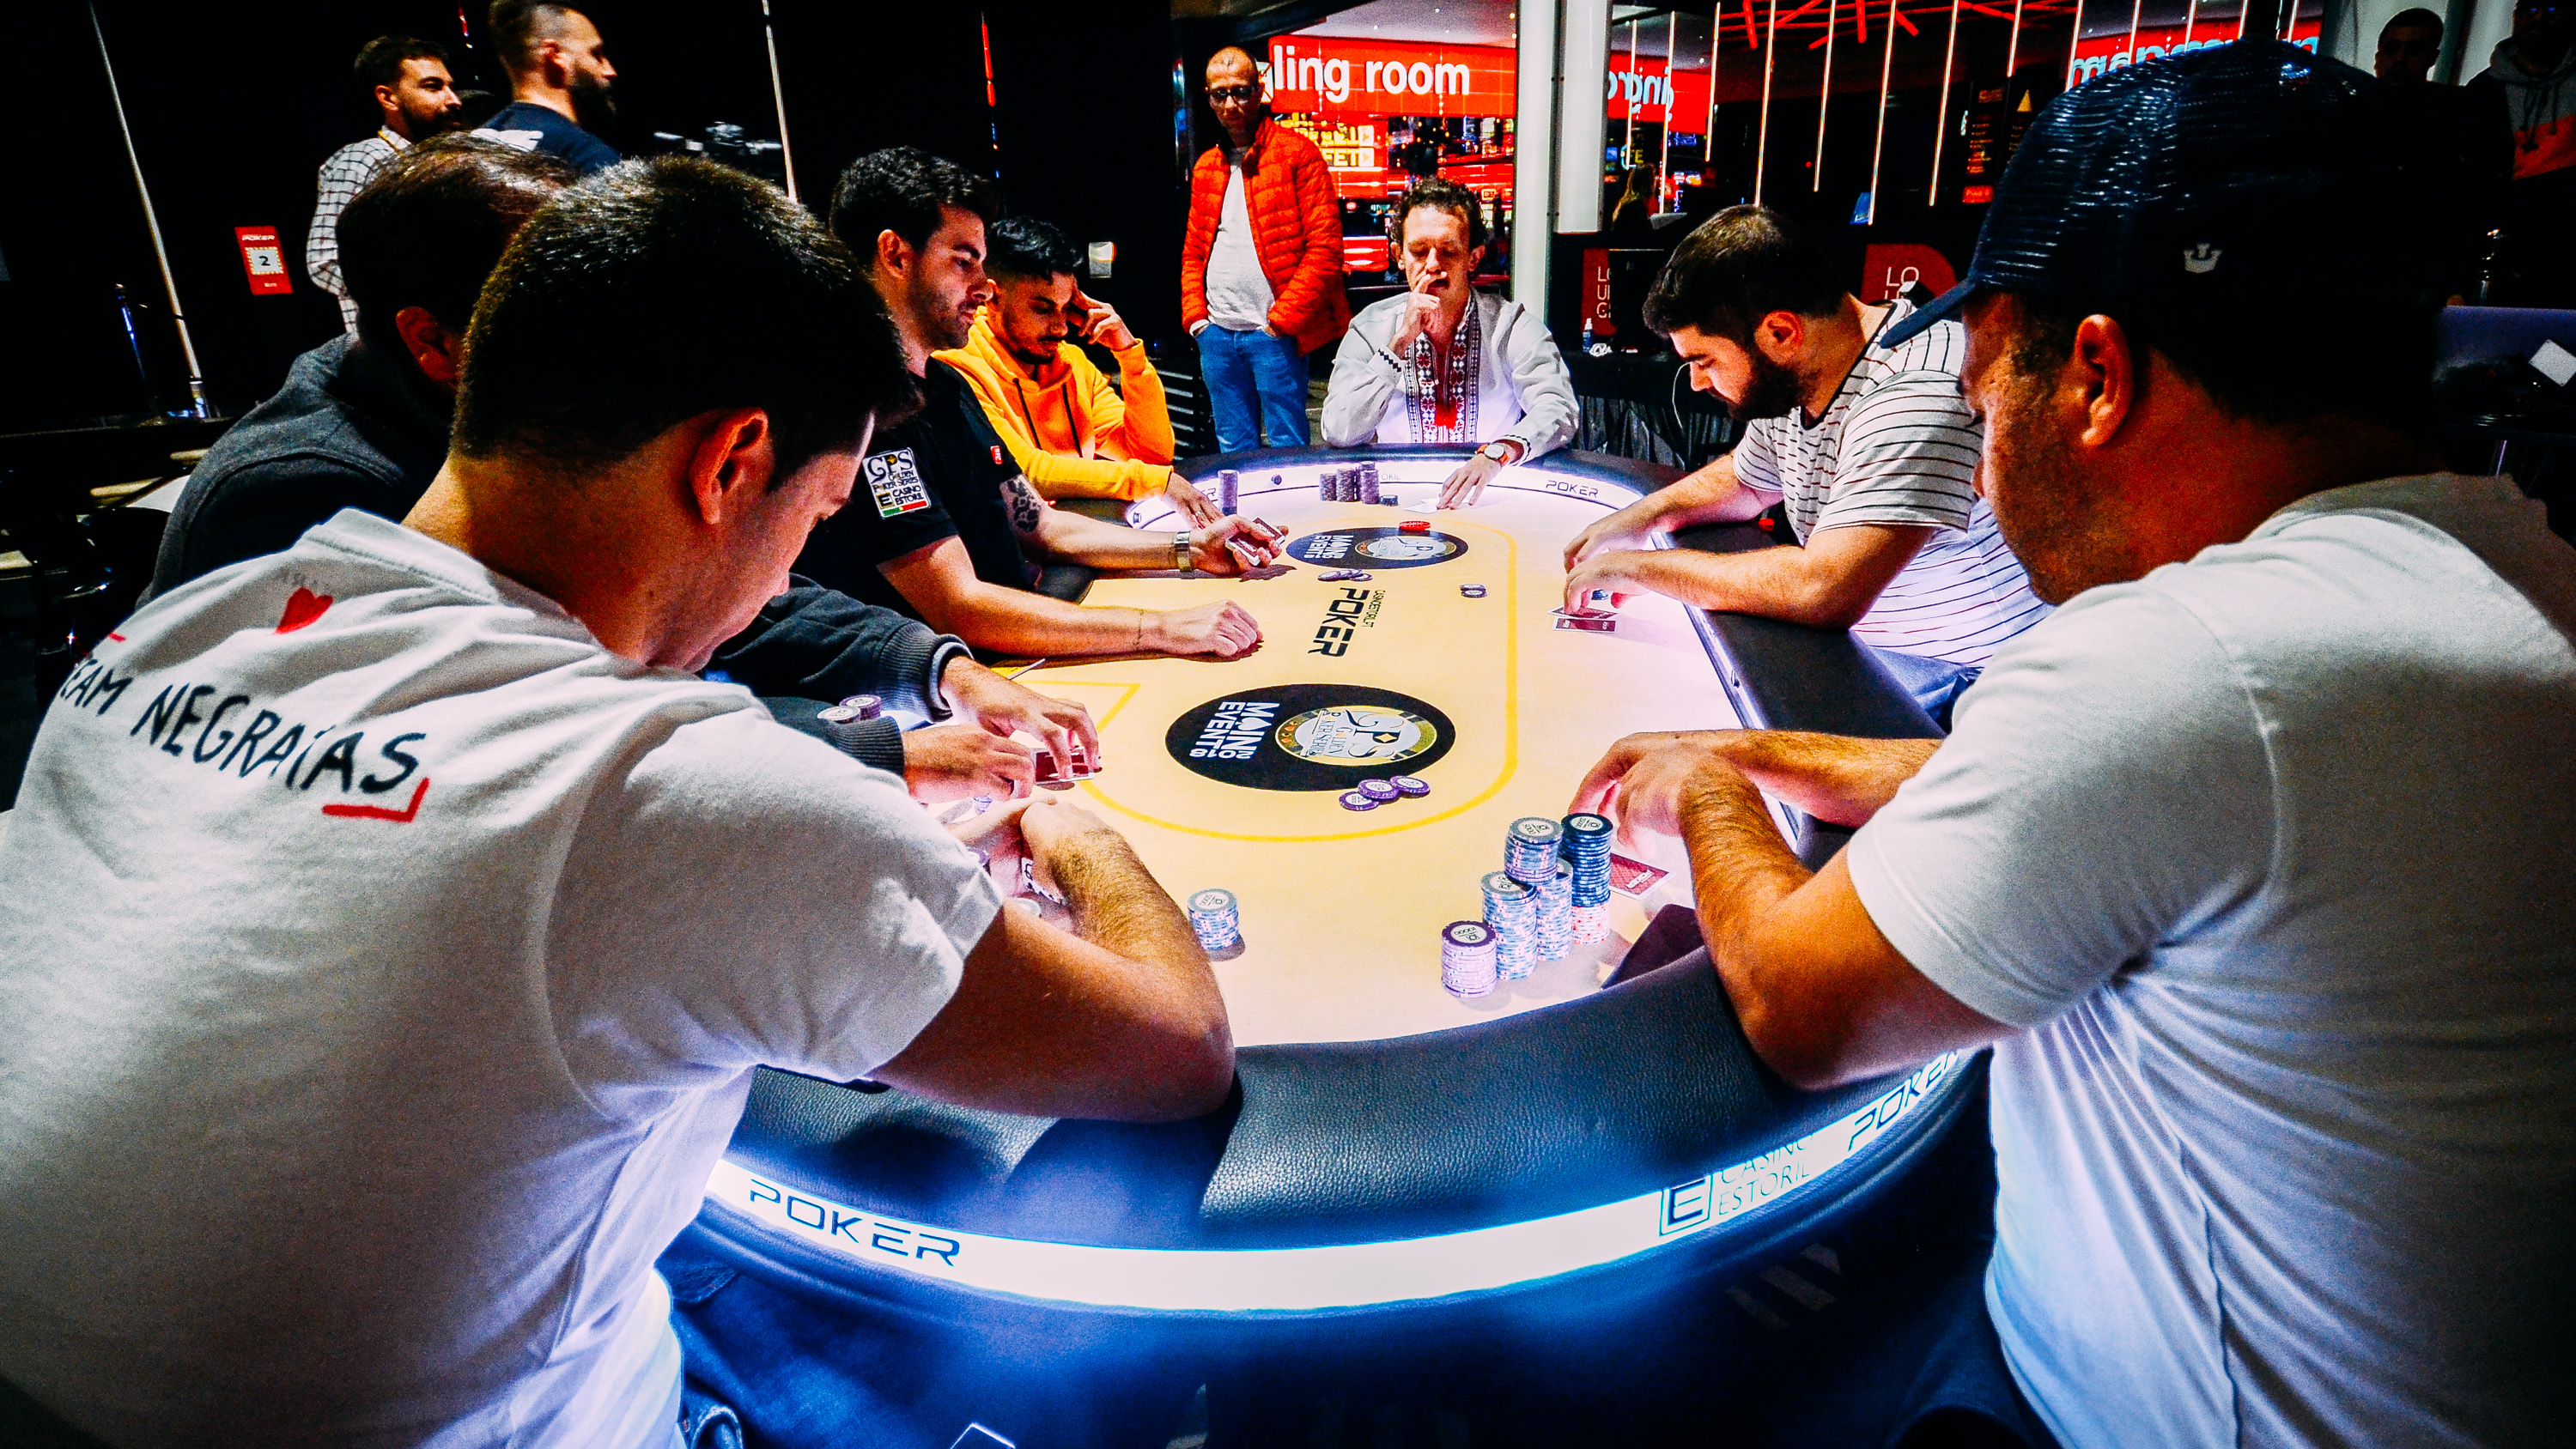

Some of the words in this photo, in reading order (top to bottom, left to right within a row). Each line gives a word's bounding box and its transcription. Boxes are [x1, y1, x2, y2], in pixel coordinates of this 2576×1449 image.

[1365, 60, 1470, 95] room
[258, 256, 270, 266] 2
[867, 452, 913, 484] GPS
[893, 485, 921, 497] CASINO
[895, 493, 924, 506] ESTORIL
[1546, 480, 1598, 498] POKER
[1308, 587, 1370, 657] POKER
[60, 658, 134, 715] EAM
[1195, 701, 1246, 749] EVENT
[1189, 748, 1255, 760] 2018
[1848, 1052, 1958, 1152] POKE
[1719, 1157, 1809, 1216] ESTORIL
[750, 1178, 960, 1266] POKER
